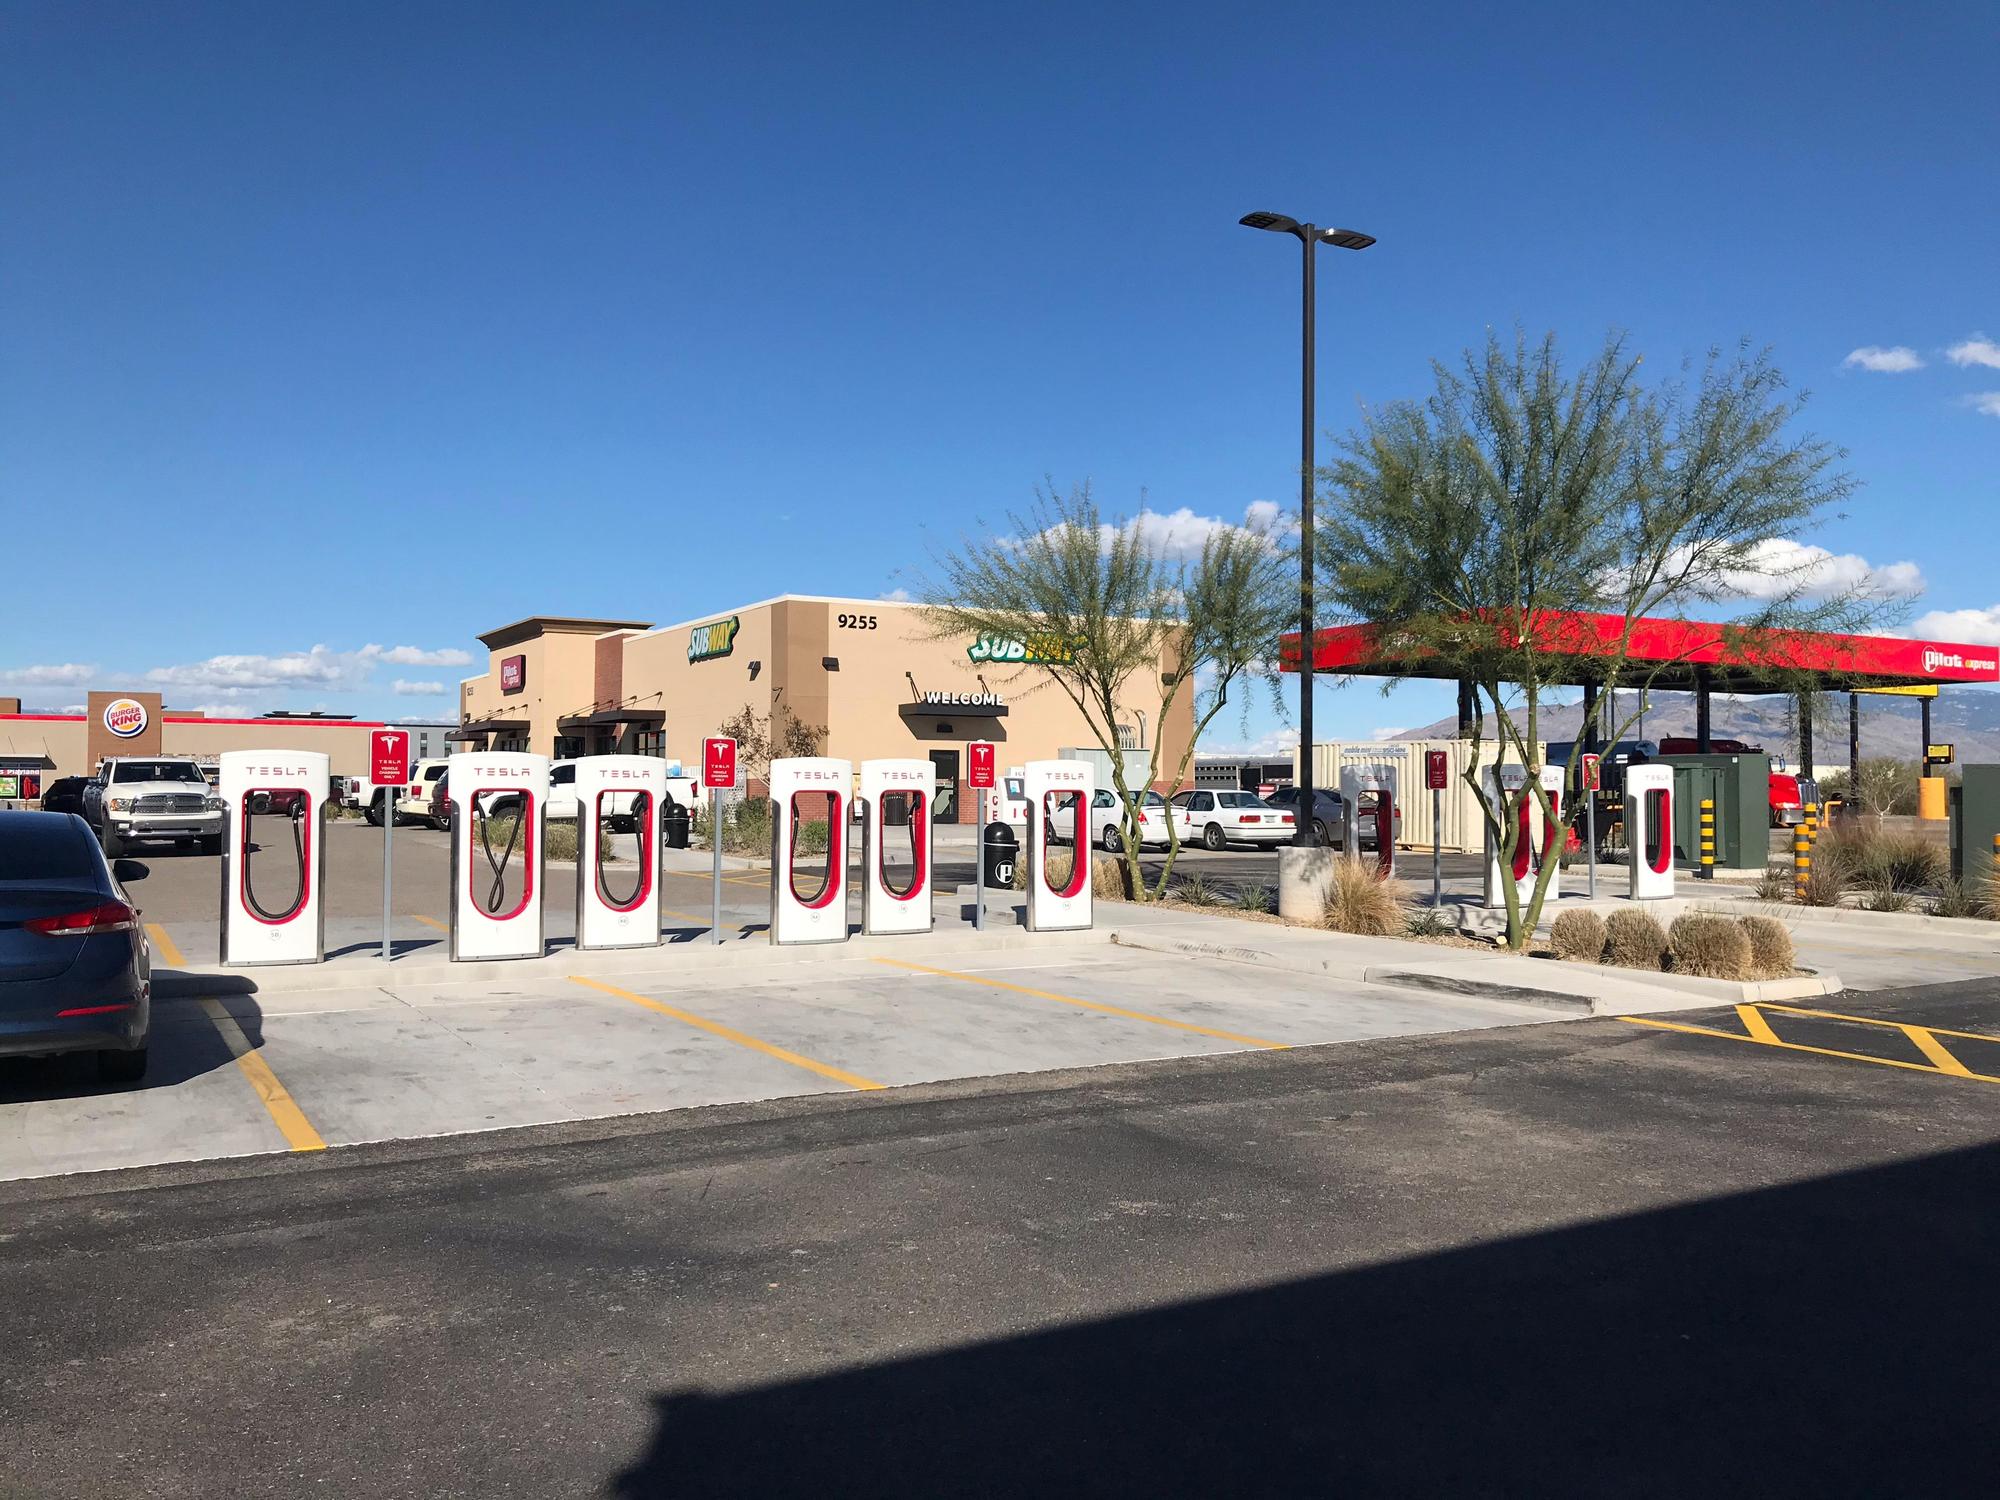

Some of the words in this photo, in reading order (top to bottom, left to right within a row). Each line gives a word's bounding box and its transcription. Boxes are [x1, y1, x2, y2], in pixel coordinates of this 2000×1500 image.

[838, 614, 877, 630] 9255
[688, 621, 735, 658] SUBWAY
[925, 691, 1004, 706] WELCOME
[110, 707, 141, 720] BURGER
[111, 713, 142, 728] KING
[245, 766, 308, 776] TESLA
[473, 767, 530, 776] TESLA
[599, 769, 650, 778] TESLA
[793, 771, 839, 780] TESLA
[882, 772, 924, 780] TESLA
[1045, 772, 1085, 780] TESLA
